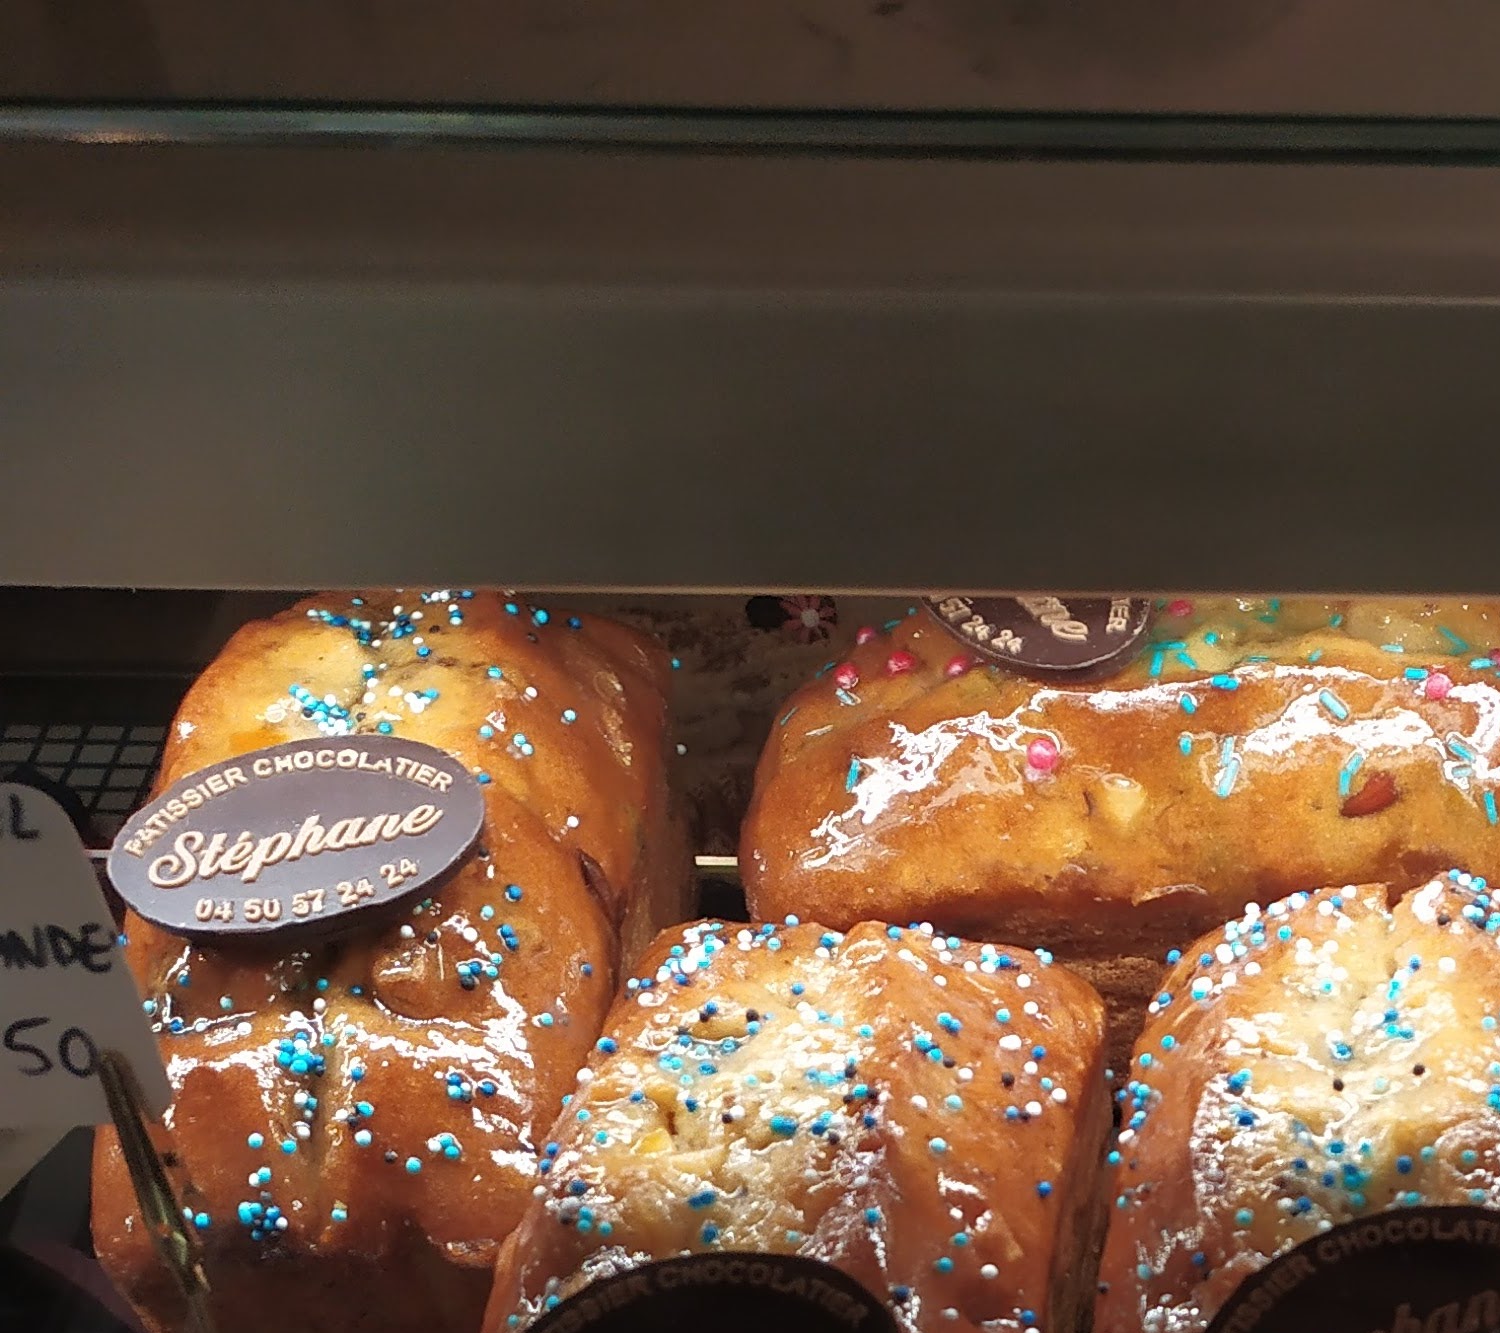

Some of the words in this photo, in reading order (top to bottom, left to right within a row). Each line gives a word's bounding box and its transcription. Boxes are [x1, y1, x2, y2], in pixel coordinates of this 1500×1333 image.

[253, 748, 453, 793] CHOCOLATIER
[149, 803, 445, 888] Stéphane
[195, 897, 234, 922] 04
[244, 898, 282, 921] 50
[292, 889, 327, 917] 57
[336, 878, 375, 907] 24
[380, 858, 418, 887] 24
